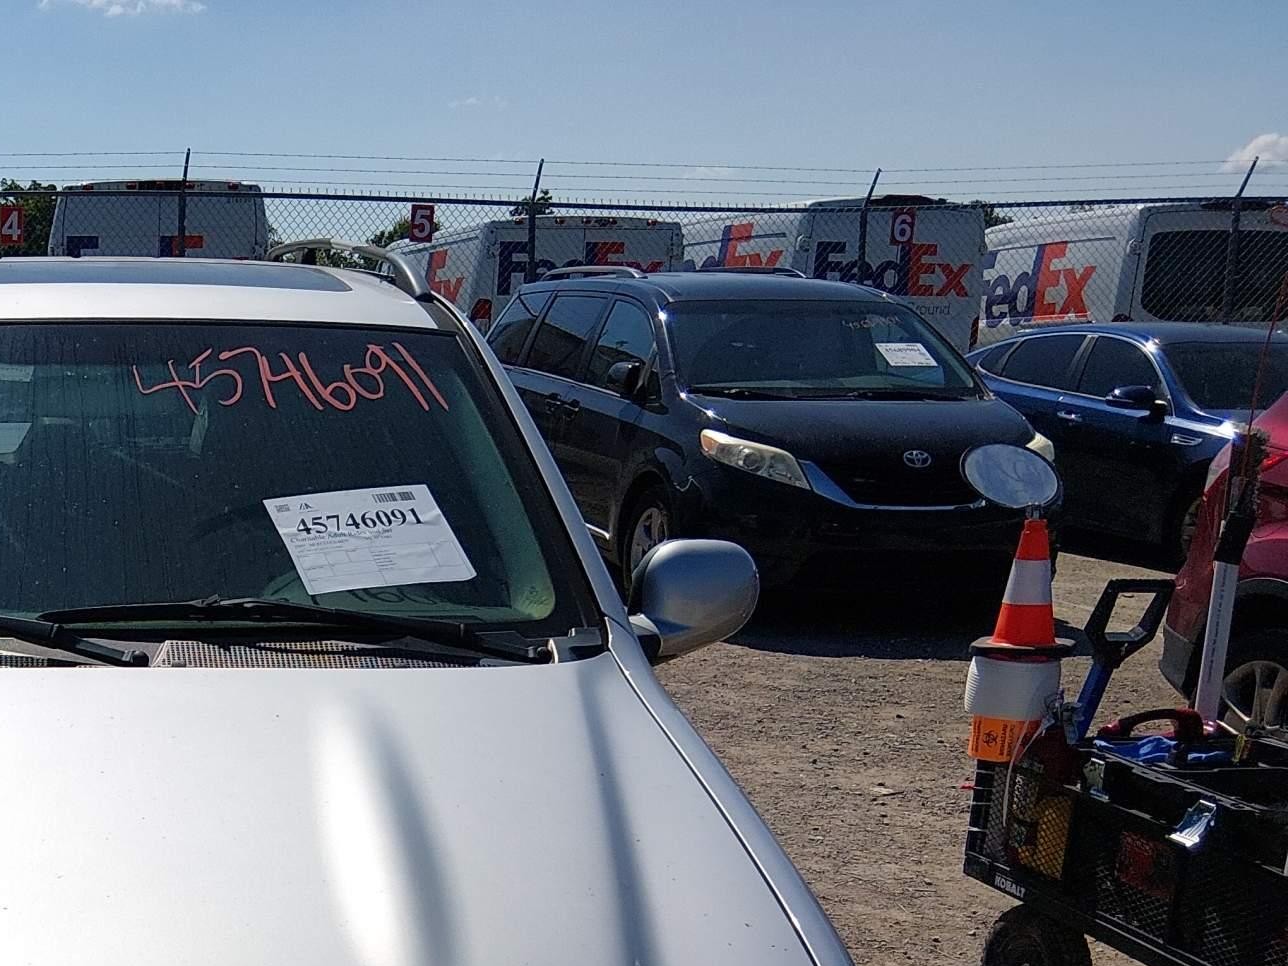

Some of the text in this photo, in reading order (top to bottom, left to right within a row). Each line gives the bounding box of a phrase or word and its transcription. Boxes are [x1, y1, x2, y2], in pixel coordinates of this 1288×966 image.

[2, 211, 21, 240] 4
[414, 209, 431, 238] 5
[894, 214, 912, 243] 6
[908, 302, 951, 316] round
[132, 342, 449, 415] 45746091
[296, 506, 424, 536] 45746091
[994, 875, 1026, 899] KOBALT
